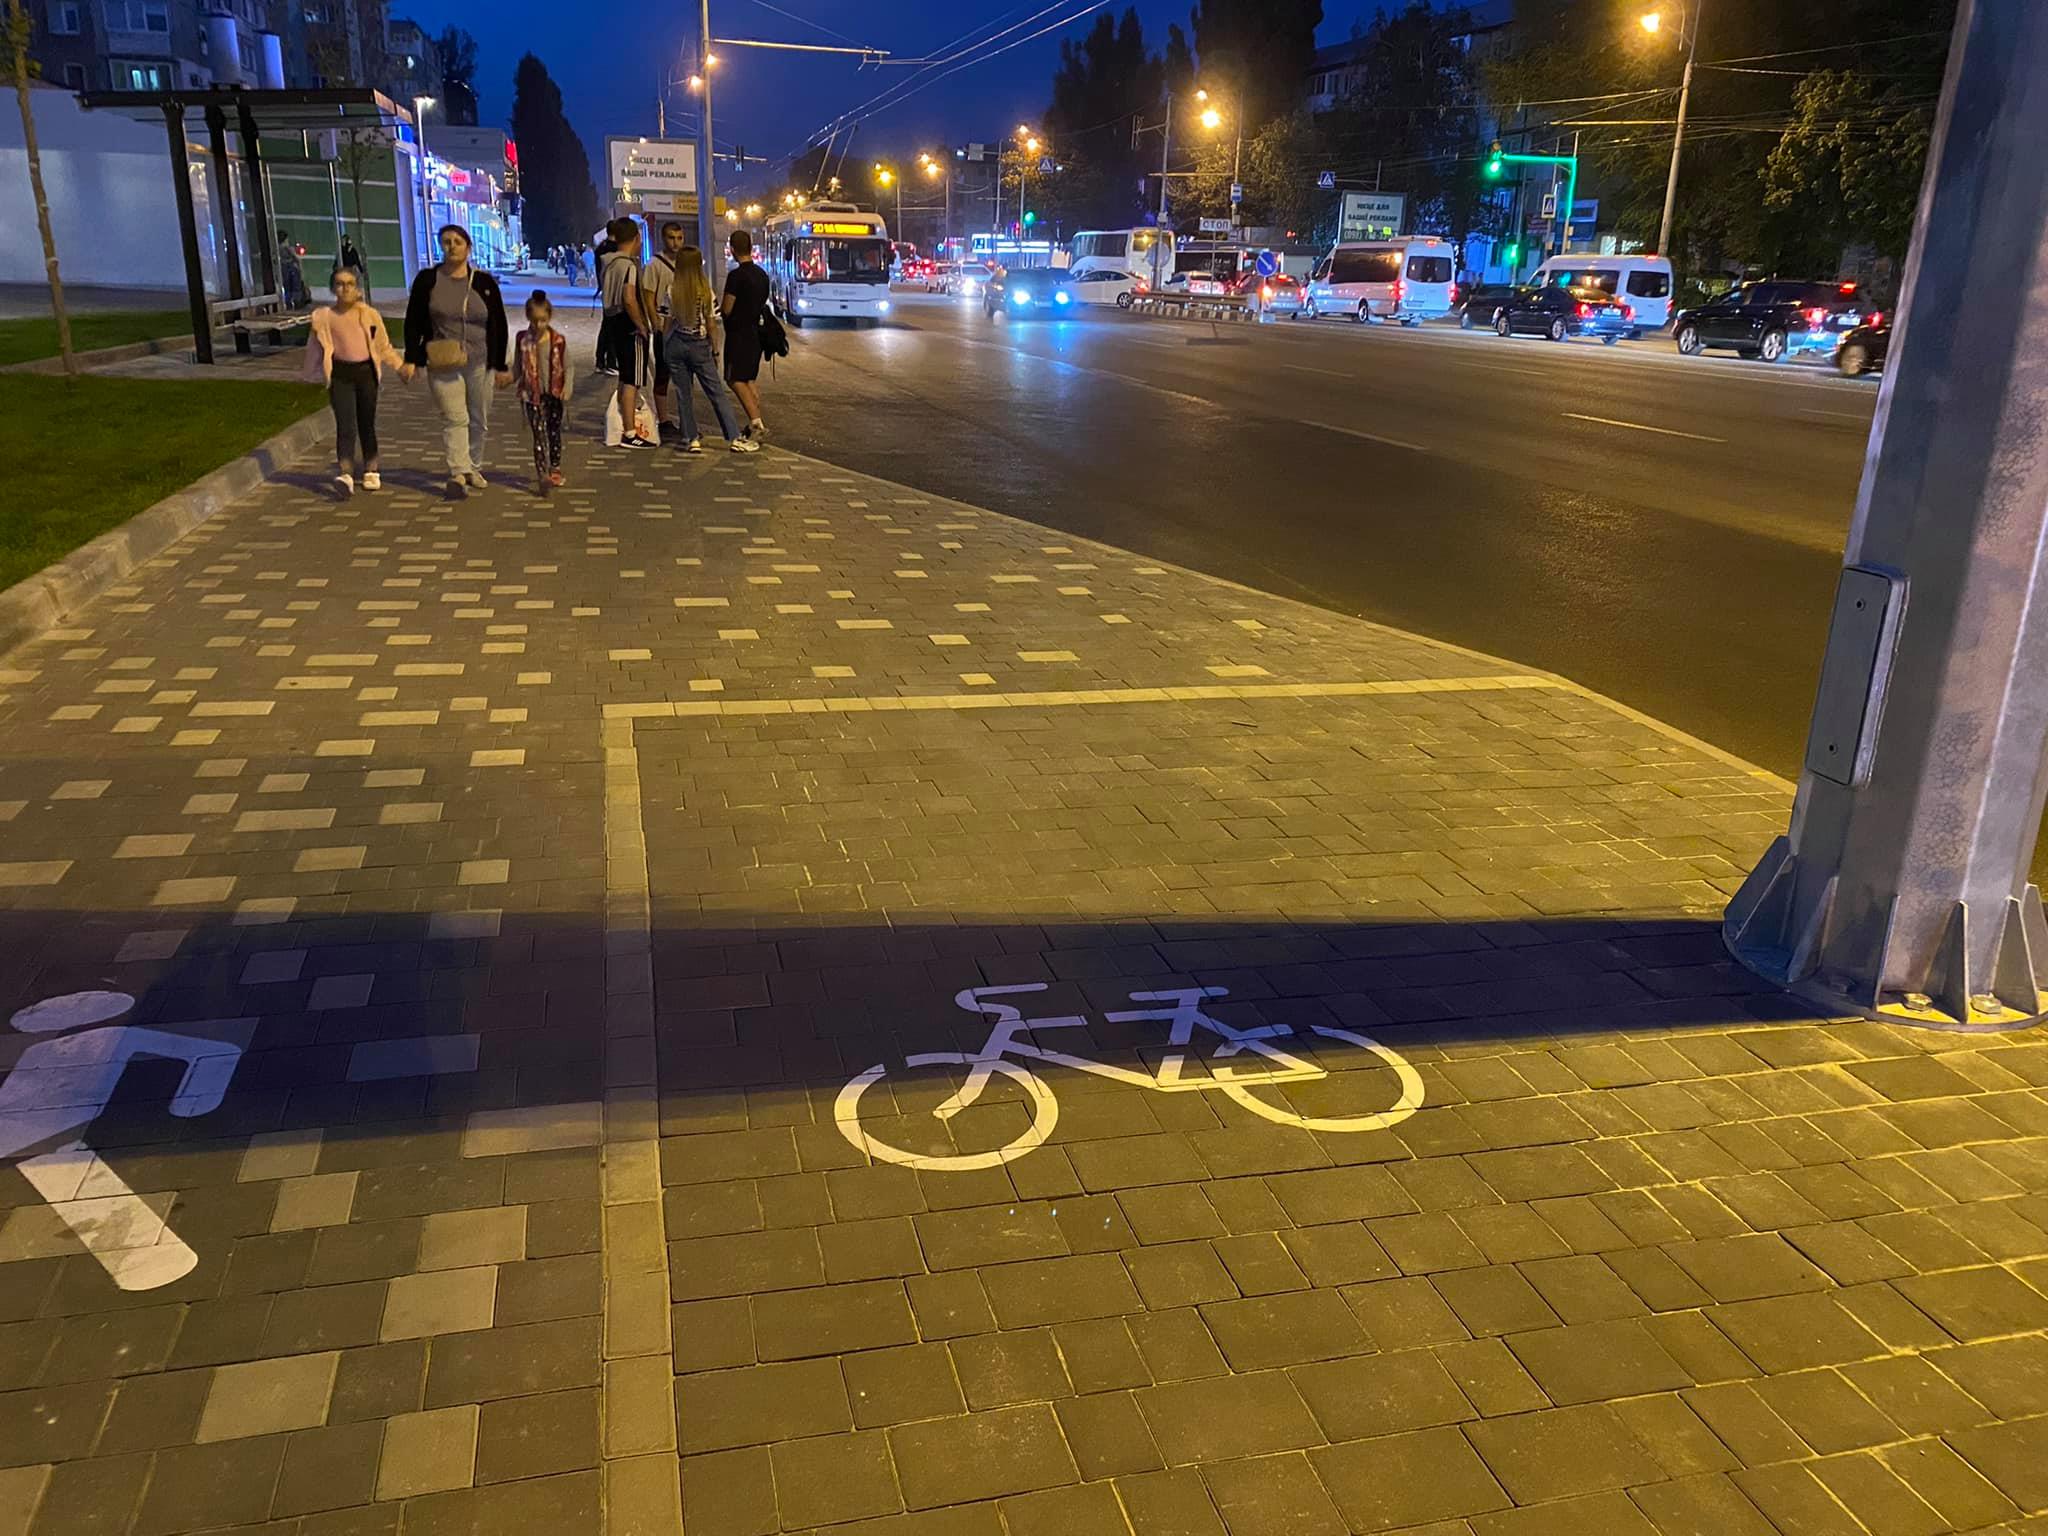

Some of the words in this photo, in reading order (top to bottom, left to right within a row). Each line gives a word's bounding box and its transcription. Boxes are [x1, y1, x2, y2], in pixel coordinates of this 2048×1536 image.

[630, 156, 654, 164] ІСЦЕ
[649, 170, 686, 178] РЕКЛАМИ
[1202, 220, 1229, 229] СТОП
